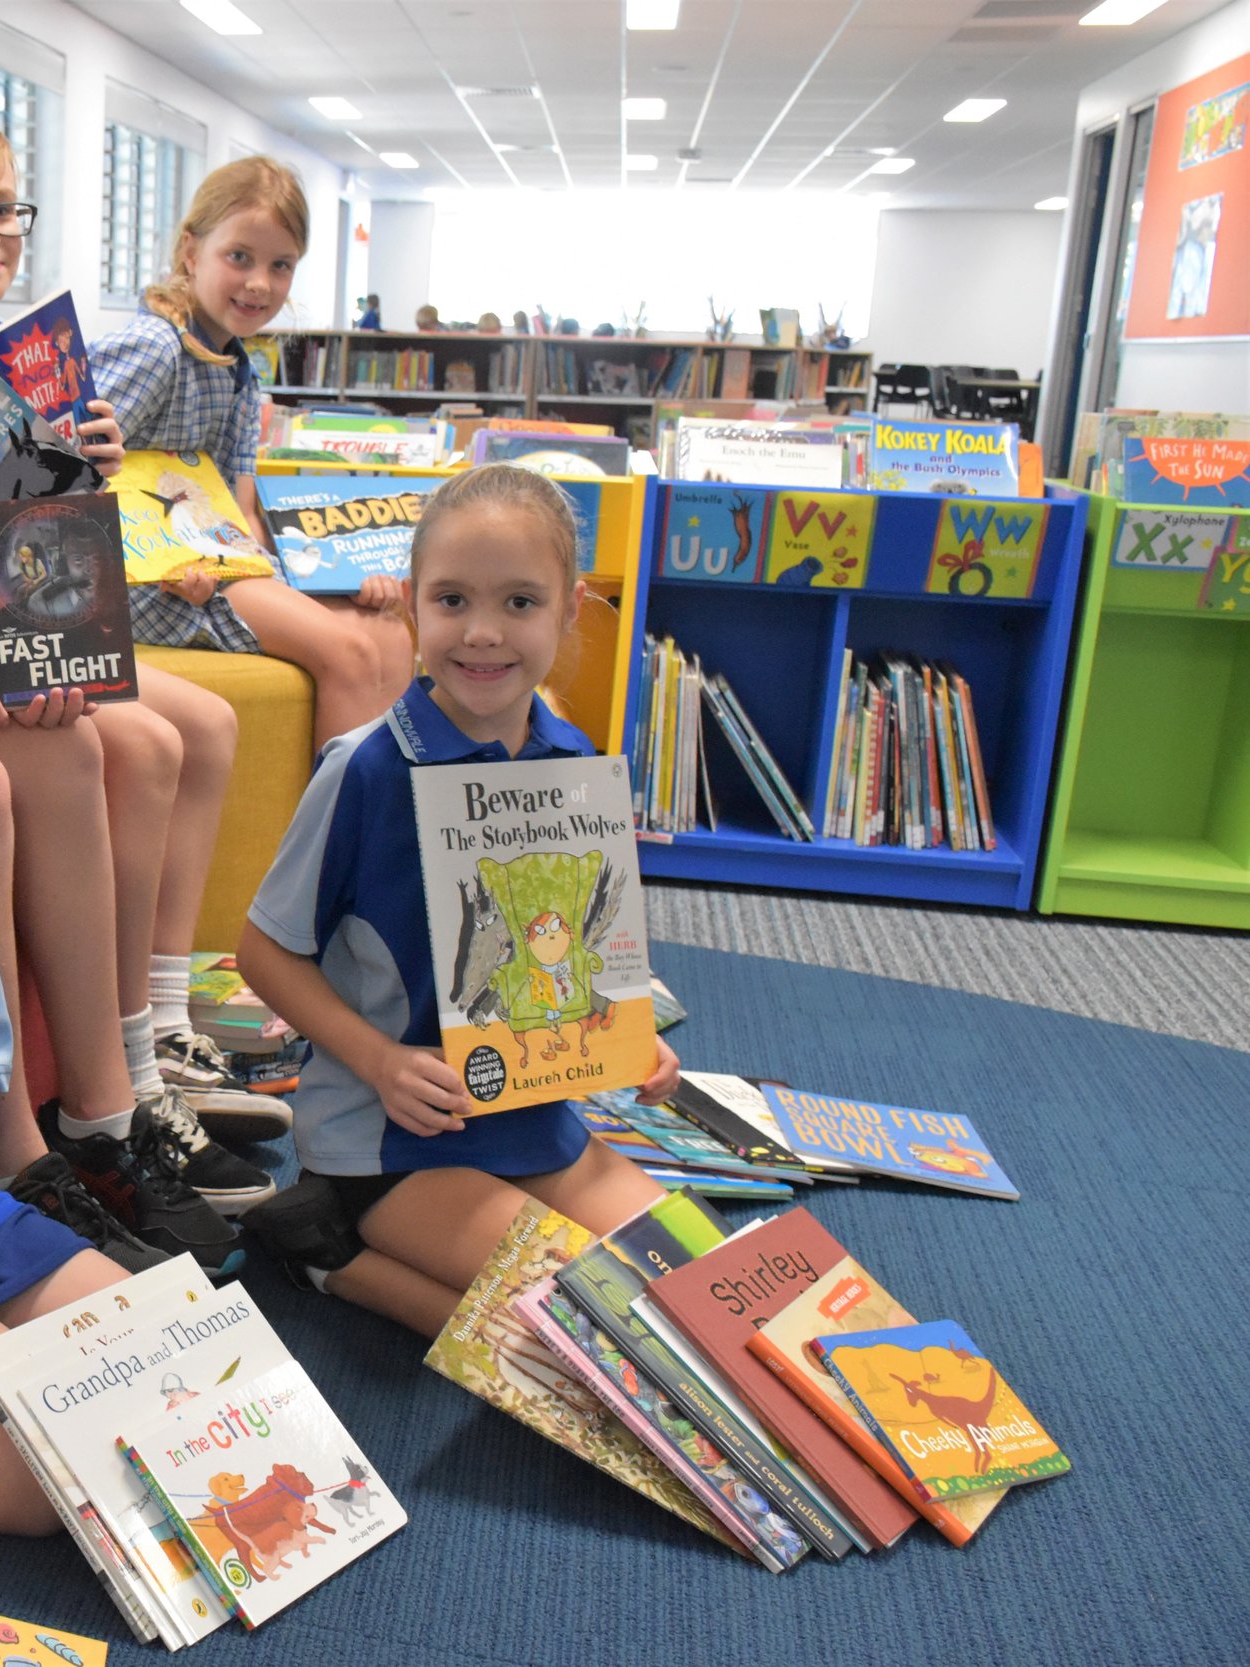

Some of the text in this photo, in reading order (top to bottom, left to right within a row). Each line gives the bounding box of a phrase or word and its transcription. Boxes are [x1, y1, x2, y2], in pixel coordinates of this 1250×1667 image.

[12, 340, 51, 375] THAI
[875, 424, 1007, 455] KOKEY KOALA
[1150, 442, 1187, 461] FIRST
[721, 446, 806, 460] Enoch the Emu
[929, 454, 953, 464] and
[891, 461, 1000, 477] the Bush Olympics
[1194, 459, 1225, 480] SUN
[277, 492, 332, 506] THERE'S
[675, 493, 723, 505] Umbrella
[1163, 513, 1226, 527] Xylophone
[784, 540, 811, 551] Vase
[382, 557, 412, 573] BO
[29, 653, 121, 687] FLIGHT
[462, 782, 588, 822] Beware of
[440, 813, 627, 851] The Storybook Wolves
[468, 1061, 502, 1074] WINNING
[469, 1052, 499, 1065] AWARD
[468, 1069, 504, 1086] fairytale
[566, 1063, 604, 1081] Child
[472, 1081, 504, 1096] TWIST
[775, 1088, 969, 1139] ROUND FISH
[786, 1105, 897, 1144] SQUARE
[793, 1121, 915, 1167] BOWL
[453, 1216, 539, 1342] Dannika Patterson Megan Forward
[710, 1249, 820, 1316] Shirley
[42, 1354, 145, 1413] Grandpa
[147, 1343, 173, 1367] and
[162, 1301, 250, 1351] Thomas
[823, 1357, 880, 1432] Cheeky Animals
[165, 1446, 187, 1468] In
[184, 1434, 210, 1458] the
[207, 1402, 270, 1449] city
[259, 1399, 273, 1415] I
[900, 1415, 1035, 1459] Cheeky Animals
[679, 1381, 835, 1540] alison lester and coral tulloch
